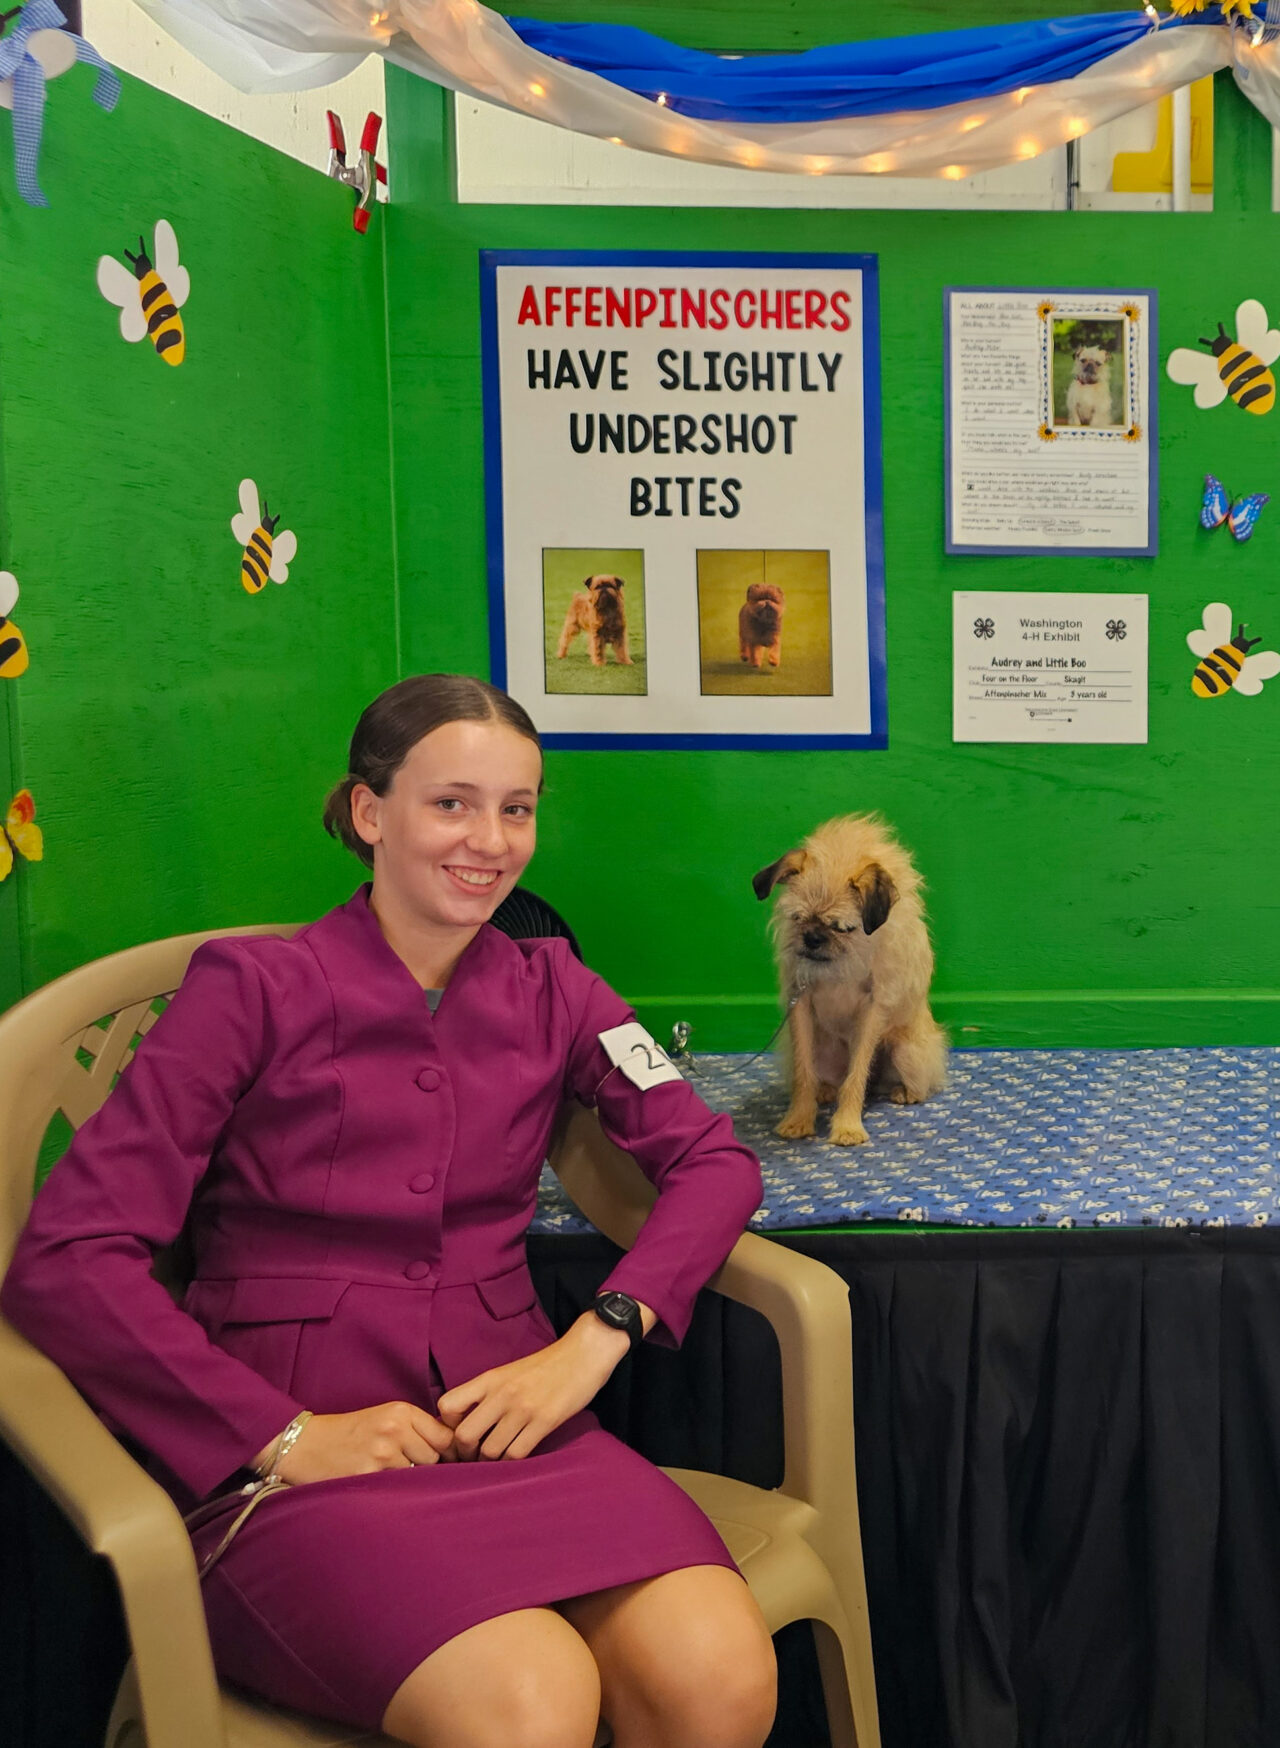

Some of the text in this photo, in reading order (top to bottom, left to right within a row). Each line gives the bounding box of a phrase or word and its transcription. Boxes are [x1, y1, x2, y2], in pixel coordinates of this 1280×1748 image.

[517, 284, 852, 333] AFFENPINSCHERS
[527, 348, 843, 393] HAVE SLIGHTLY
[569, 412, 798, 456] UNDERSHOT
[630, 476, 743, 519] BITES
[1020, 618, 1083, 630] Washington
[1022, 632, 1081, 642] 4-H Exhibit
[991, 656, 1023, 669] Audrey
[1026, 657, 1043, 668] and
[1045, 657, 1069, 668] Little
[1071, 657, 1087, 668] Boo
[982, 674, 996, 682] Four
[1009, 674, 1020, 682] the
[1022, 674, 1038, 683] Floor
[1064, 675, 1086, 684] Skagit
[1033, 689, 1047, 698] Mix
[1077, 691, 1096, 699] years
[1097, 690, 1107, 698] old
[630, 1042, 667, 1070] 2
